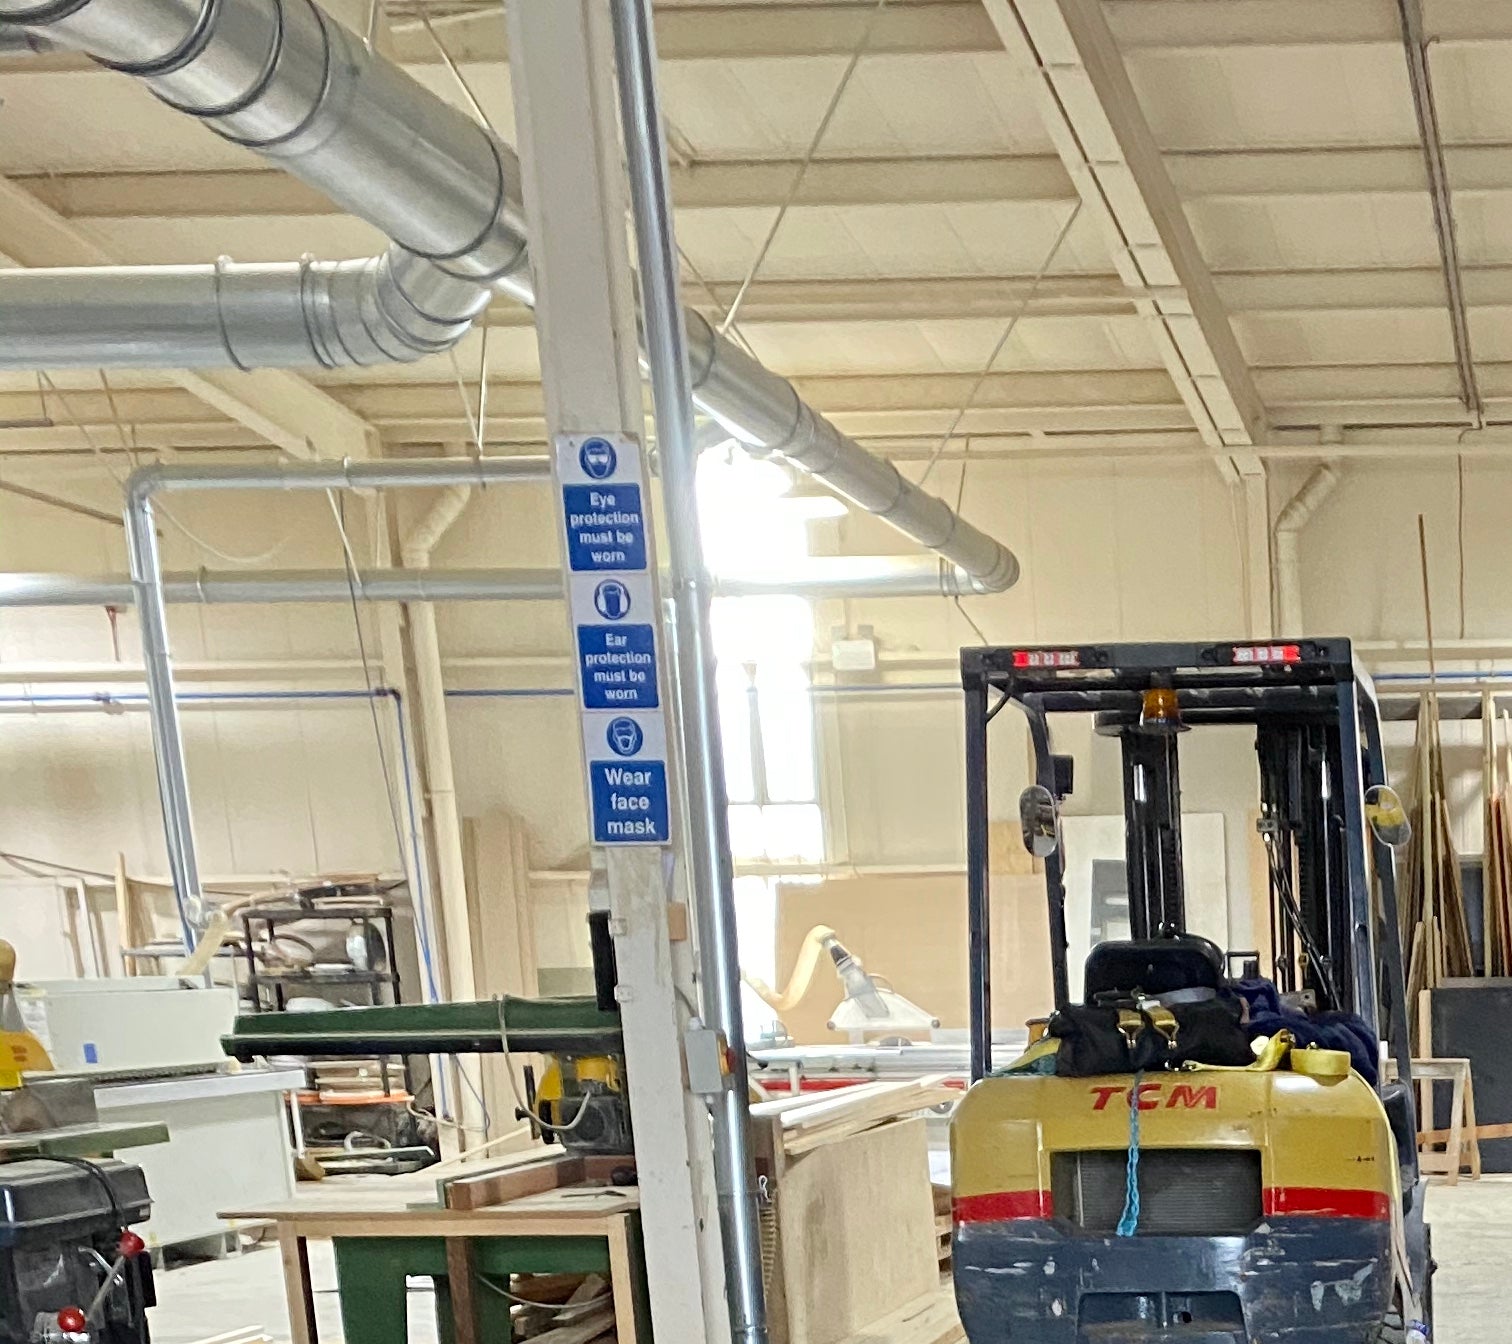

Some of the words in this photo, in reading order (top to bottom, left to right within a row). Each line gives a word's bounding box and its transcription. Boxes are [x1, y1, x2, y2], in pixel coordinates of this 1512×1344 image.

[590, 492, 616, 510] Eye
[570, 511, 640, 529] protection
[580, 531, 614, 544] must
[616, 530, 634, 544] be
[591, 551, 626, 562] worn
[605, 633, 628, 646] Ear
[585, 651, 652, 668] protection
[594, 670, 626, 682] must
[629, 669, 647, 682] be
[604, 689, 638, 700] worn
[604, 768, 652, 786] Wear
[610, 792, 650, 810] face
[607, 817, 657, 834] mask
[1090, 1083, 1217, 1110] TCM
